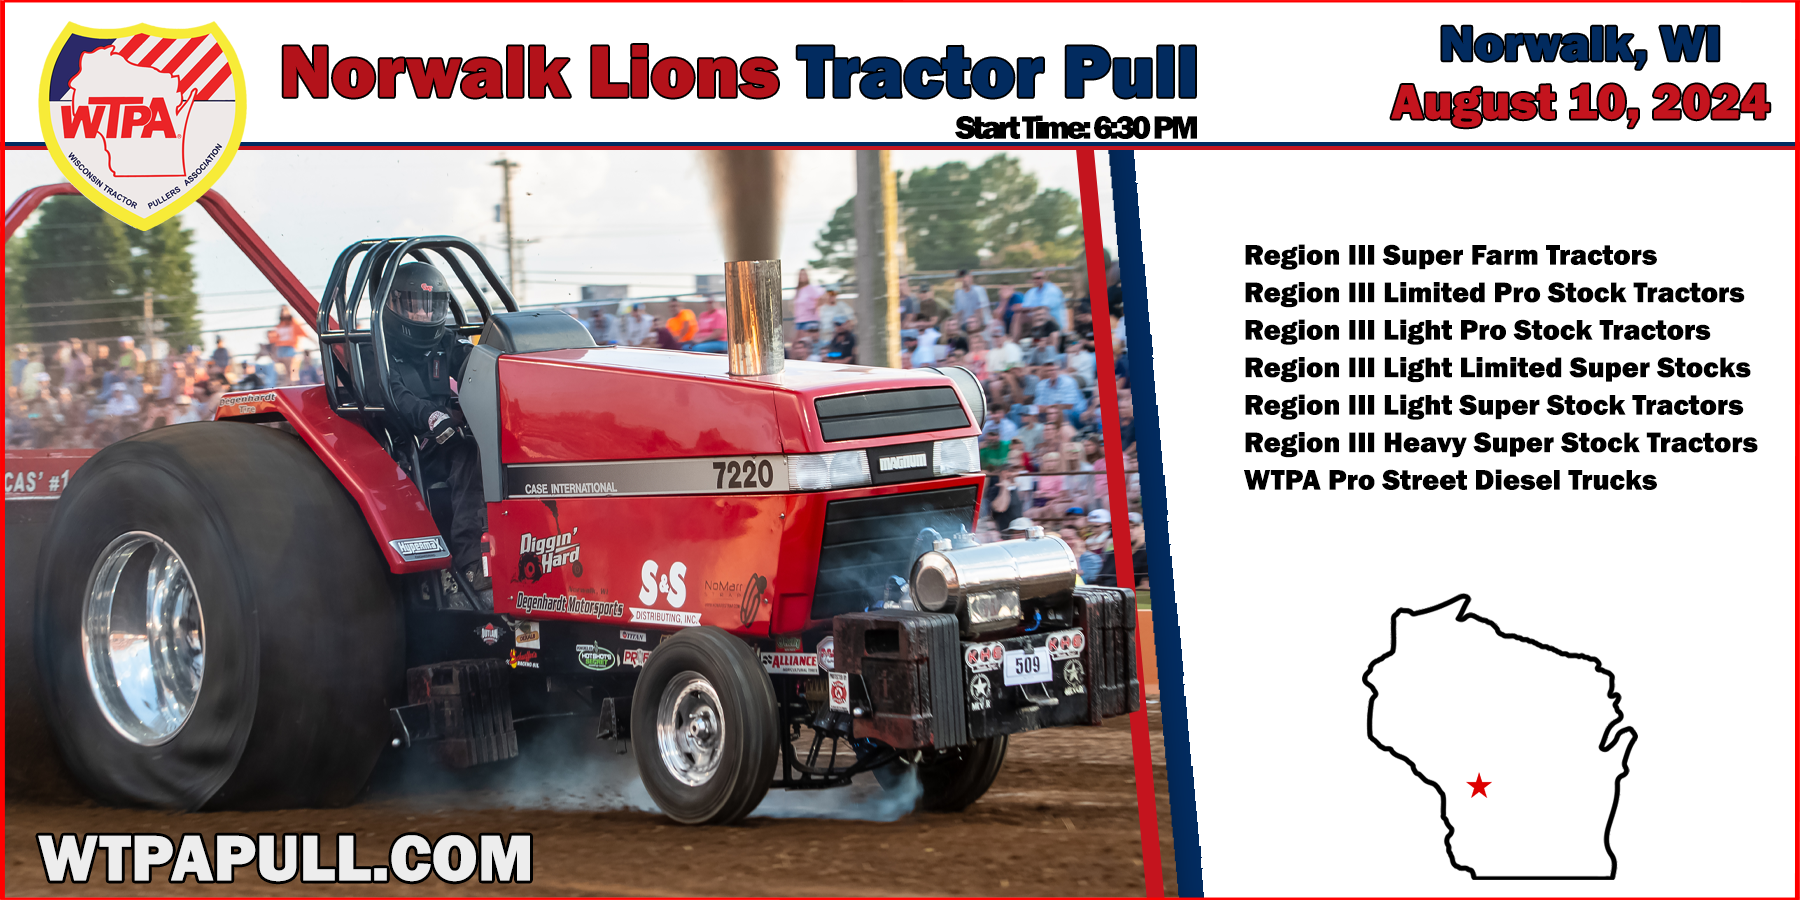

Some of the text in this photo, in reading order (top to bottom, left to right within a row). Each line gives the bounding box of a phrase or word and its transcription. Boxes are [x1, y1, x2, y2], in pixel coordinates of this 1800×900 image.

[219, 393, 276, 407] Degenhardt
[239, 405, 256, 413] Tire
[713, 460, 773, 488] 7220
[525, 482, 617, 494] CASE INTERNATIONAL
[520, 527, 578, 555] Diggin'
[542, 546, 580, 574] Hard
[639, 559, 687, 608] S&S
[705, 581, 743, 591] NoMarr
[516, 591, 624, 619] Degenhardt Motorsports
[636, 611, 699, 624] DISTRIBUTING, INC.
[627, 633, 644, 641] TITAN
[772, 655, 816, 668] ALLIANCE
[1015, 656, 1040, 675] 509
